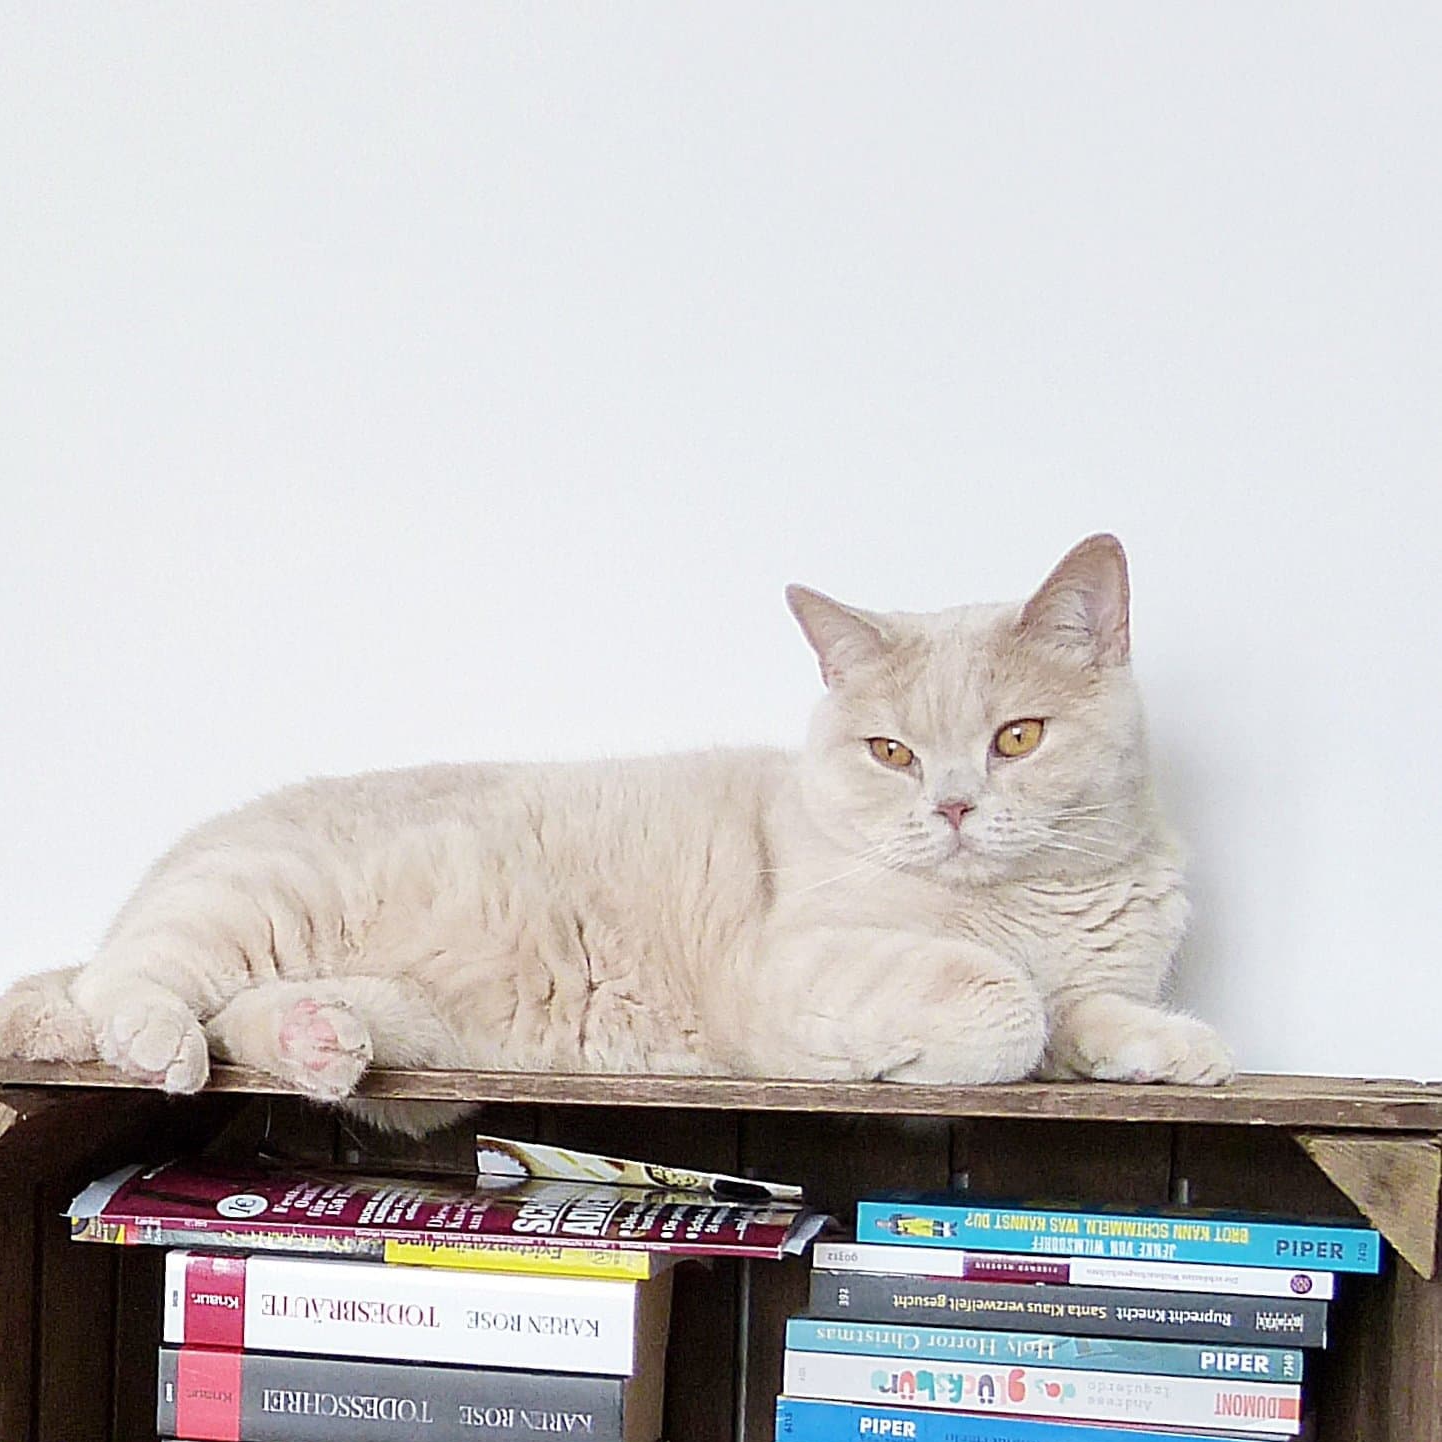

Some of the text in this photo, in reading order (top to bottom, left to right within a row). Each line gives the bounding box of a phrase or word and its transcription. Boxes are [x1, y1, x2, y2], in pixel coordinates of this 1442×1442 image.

[994, 1213, 1250, 1245] BROT KANN WAS KANNST
[1137, 1240, 1177, 1259] JENKE
[1276, 1239, 1343, 1260] PIPER
[191, 1292, 240, 1310] Knaur.
[261, 1293, 440, 1330] TODESBRÄUTE
[893, 1292, 1232, 1327] Ruprecht Knecht Santa Klaus verzweifelt gesucht
[466, 1310, 600, 1338] KAREN ROSE
[815, 1326, 997, 1357] Horror Christmas
[1200, 1351, 1270, 1373] PIPER
[262, 1388, 433, 1424] TODESSCHREI
[459, 1405, 514, 1428] ROSE
[1213, 1392, 1279, 1419] DUMONT
[859, 1415, 916, 1438] PIPER
